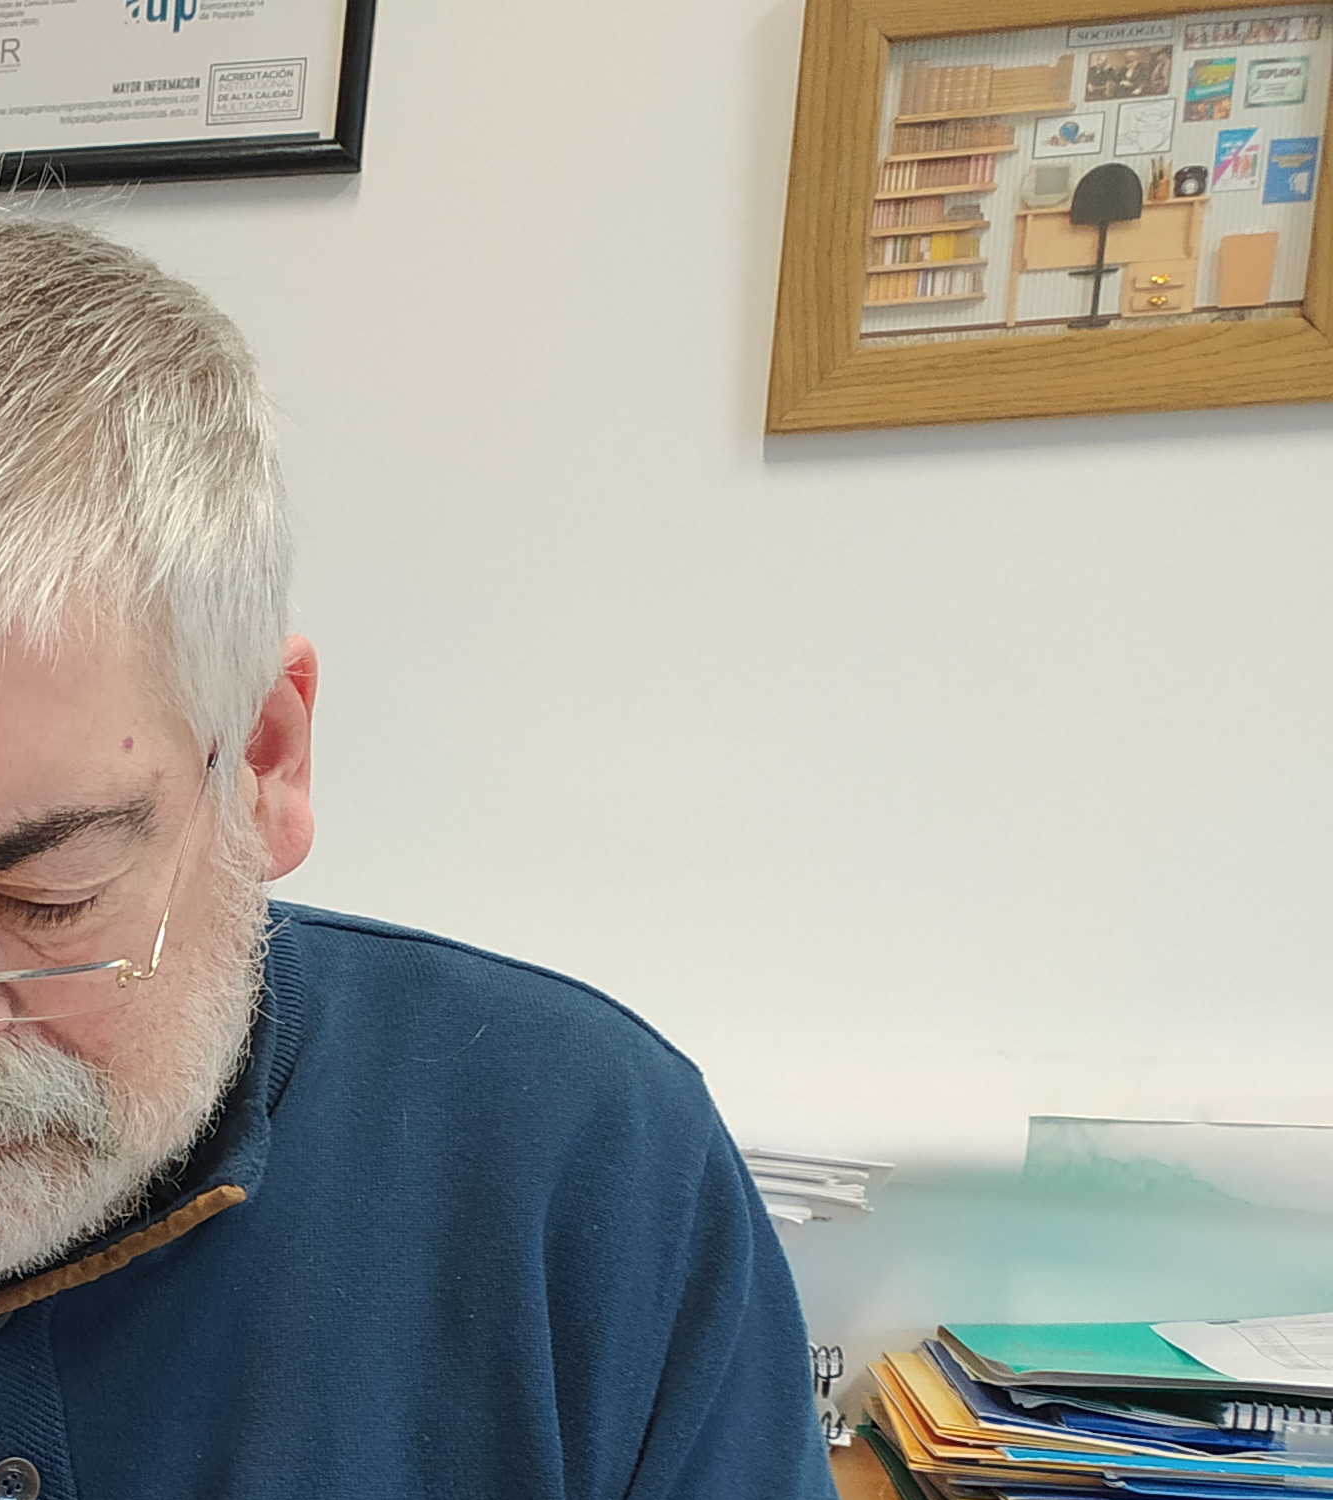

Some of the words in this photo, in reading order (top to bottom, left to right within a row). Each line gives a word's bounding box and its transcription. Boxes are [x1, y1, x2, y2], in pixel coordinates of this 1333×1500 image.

[199, 11, 209, 20] de
[212, 9, 255, 20] Postgrado
[112, 80, 141, 95] MAYOR
[217, 80, 293, 92] INSTITUCIONAL
[217, 94, 229, 102] DE
[230, 91, 253, 101] ALTA
[255, 89, 294, 100] CALIDAD
